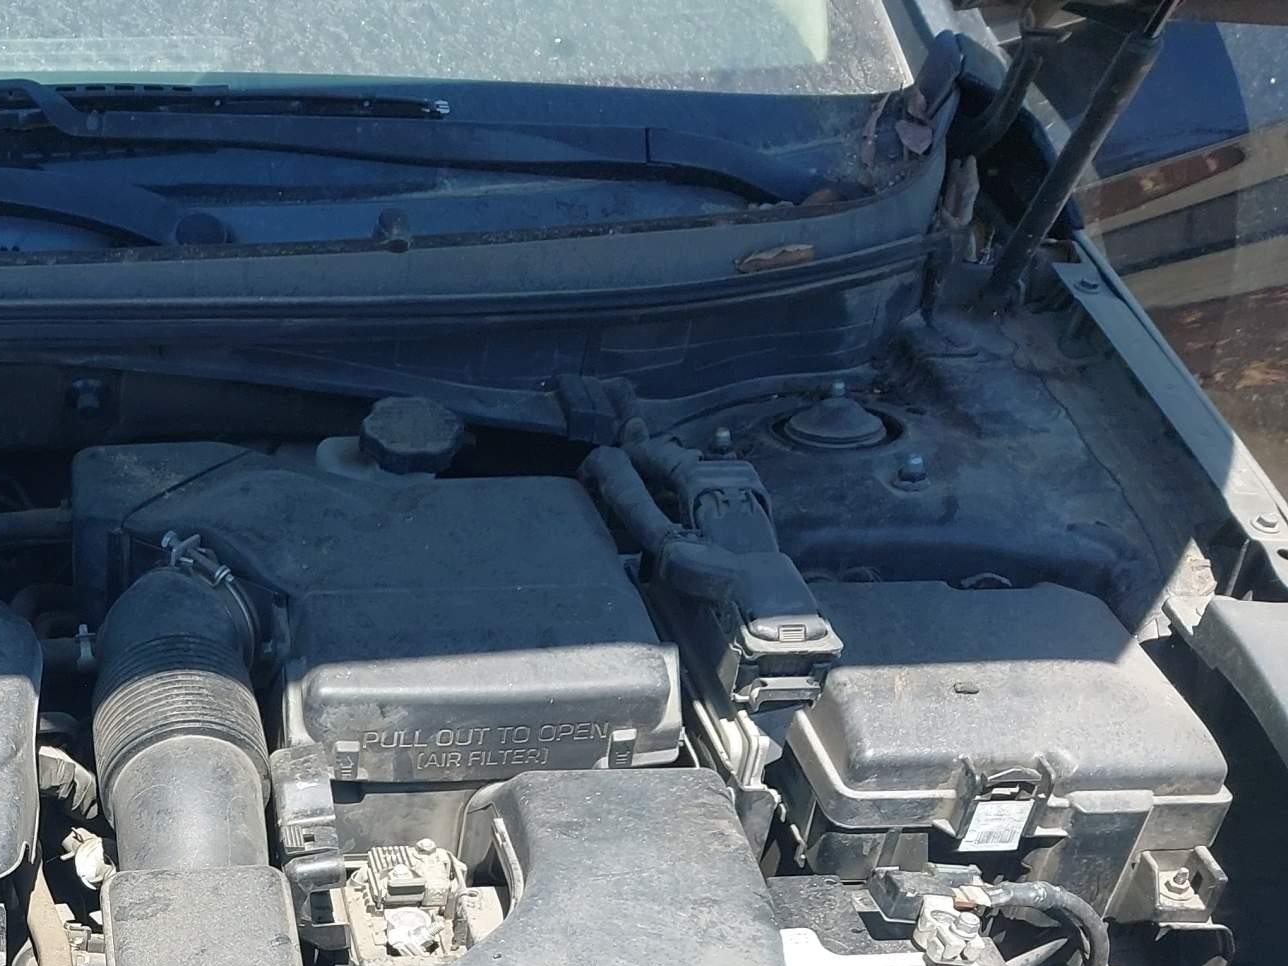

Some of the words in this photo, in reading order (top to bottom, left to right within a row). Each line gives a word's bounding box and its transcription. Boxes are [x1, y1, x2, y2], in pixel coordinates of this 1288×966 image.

[362, 729, 428, 749] PULL
[435, 727, 491, 747] OUT
[497, 725, 530, 745] TO
[537, 721, 610, 743] OPEN
